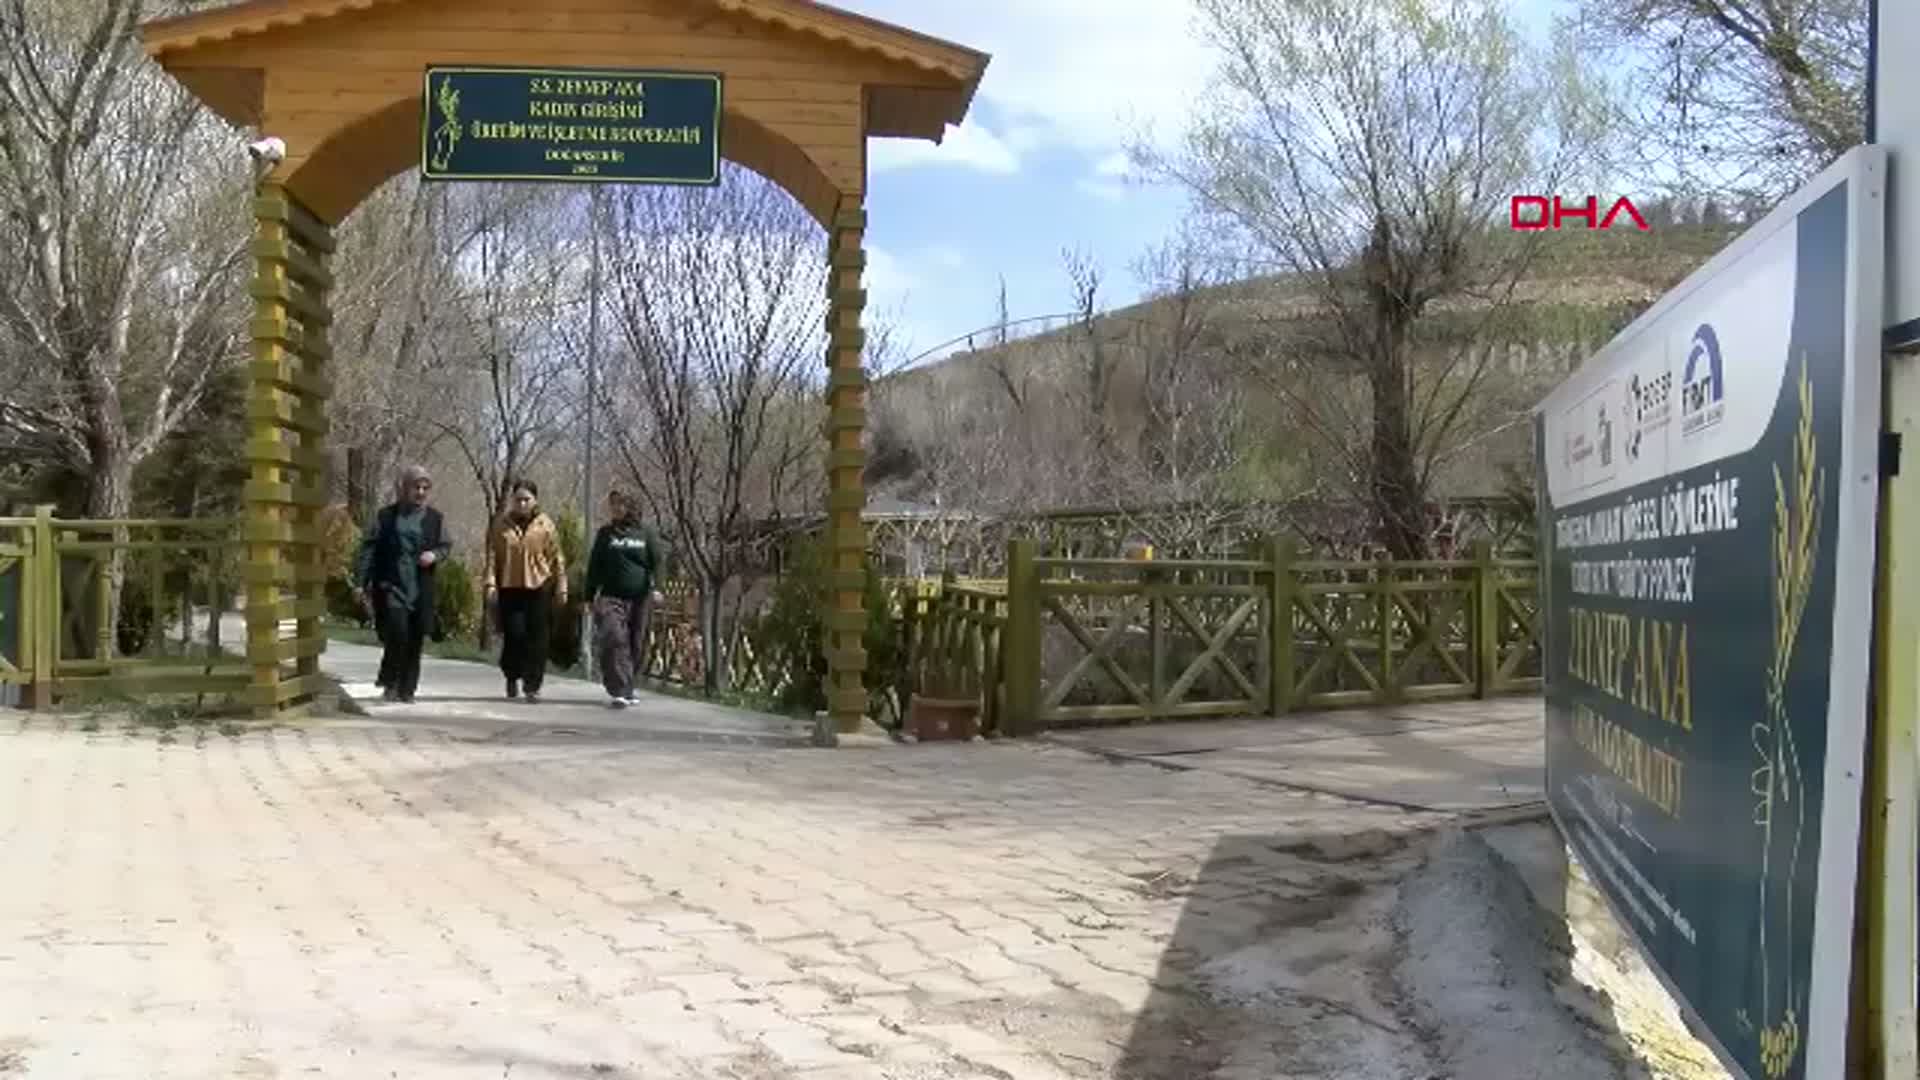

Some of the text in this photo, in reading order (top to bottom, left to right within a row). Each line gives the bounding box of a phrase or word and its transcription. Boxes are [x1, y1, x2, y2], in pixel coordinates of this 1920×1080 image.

[557, 79, 612, 95] ZEYNEP
[614, 80, 646, 97] ANA
[529, 100, 577, 117] KADIN
[1631, 615, 1694, 732] ANA
